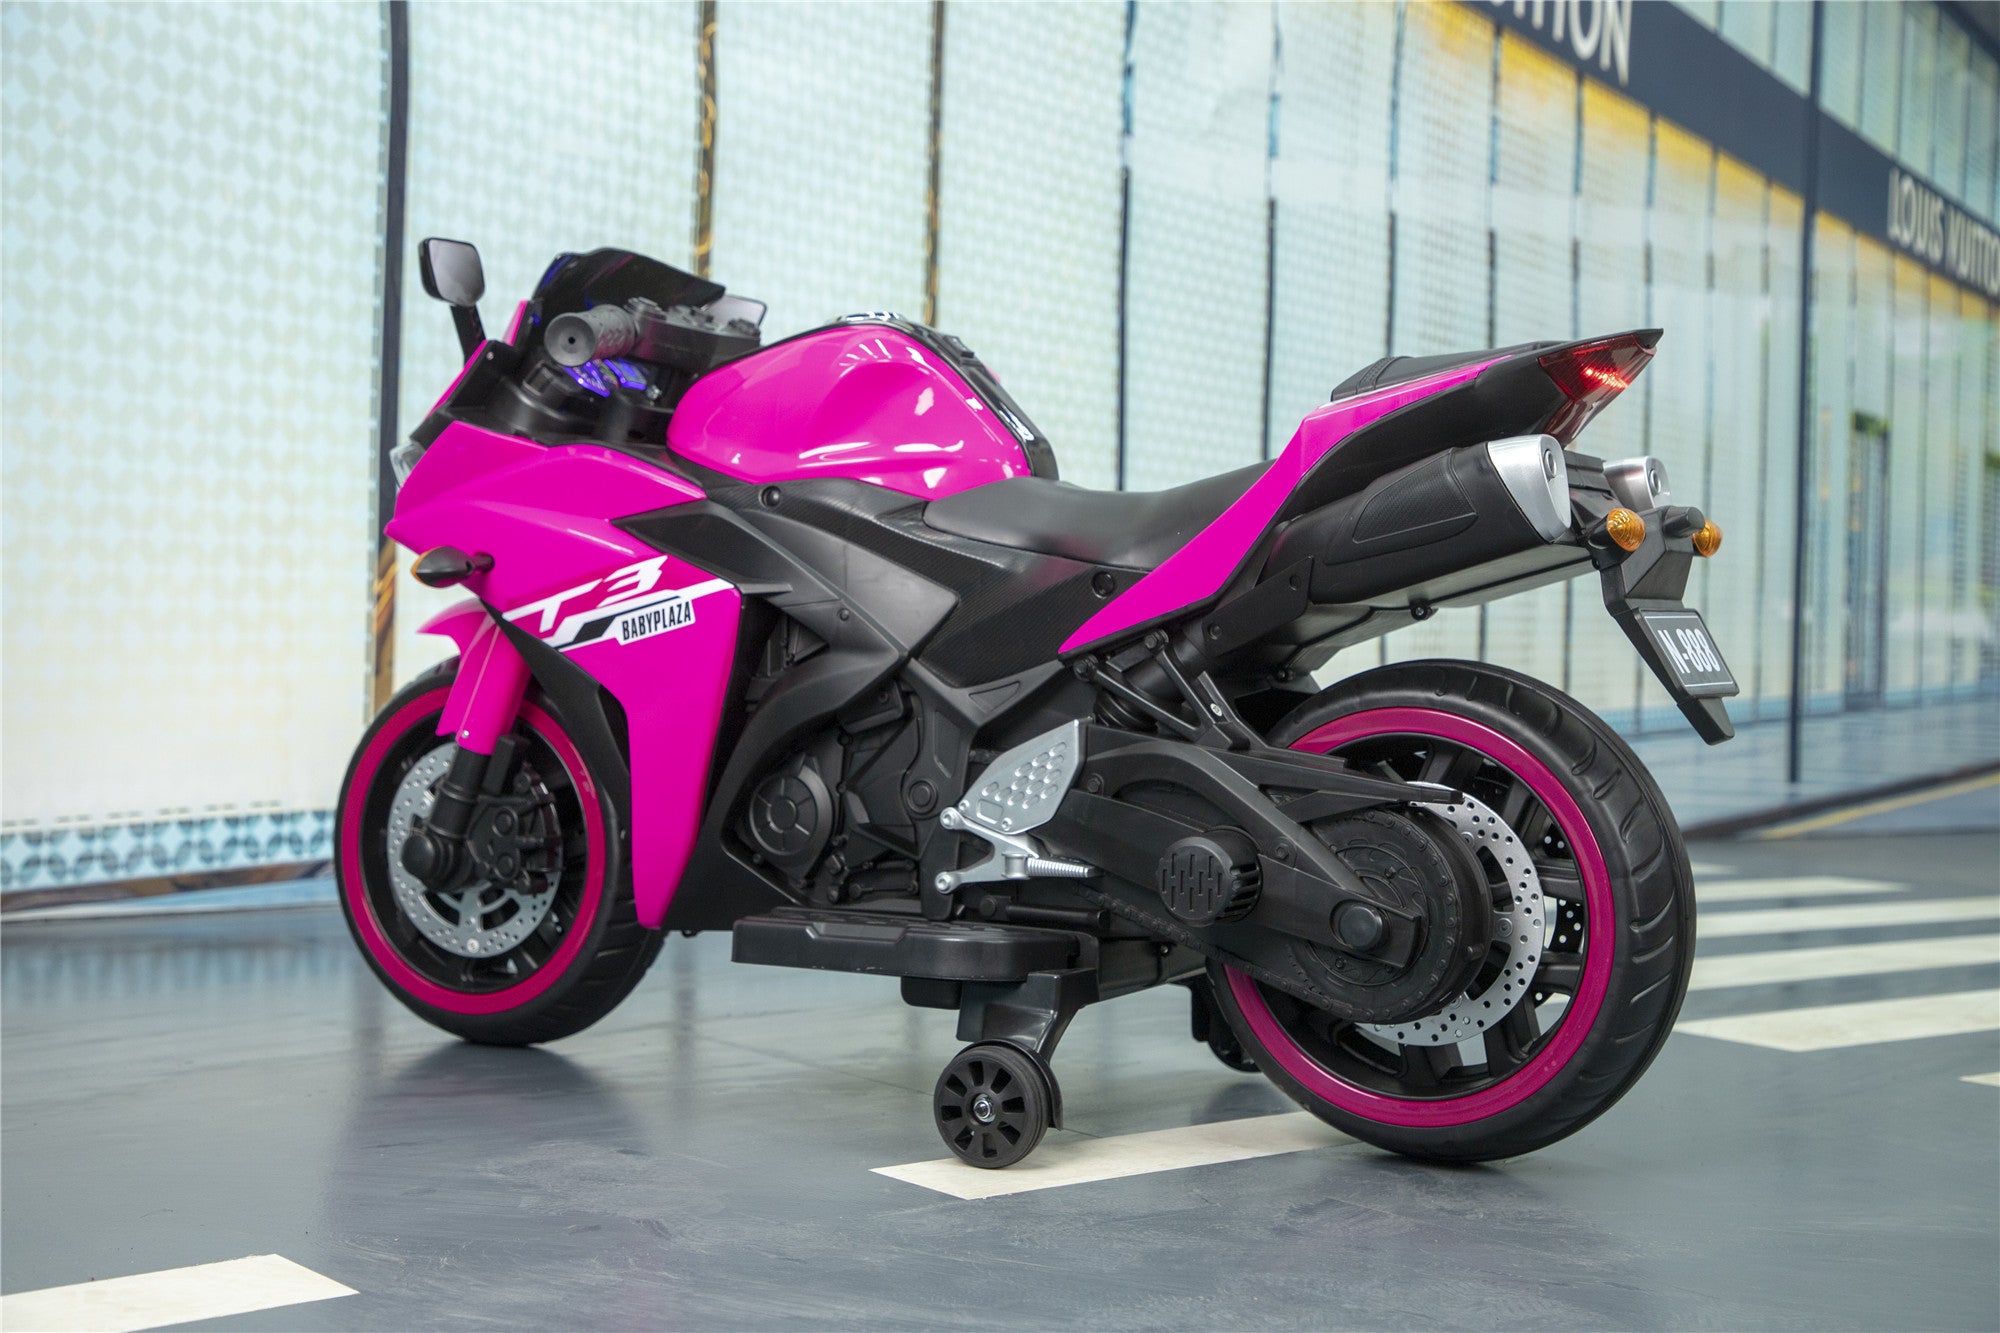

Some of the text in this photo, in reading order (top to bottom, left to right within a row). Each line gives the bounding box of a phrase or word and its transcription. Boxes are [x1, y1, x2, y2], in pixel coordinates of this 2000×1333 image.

[1887, 168, 1943, 265] LOUIS
[622, 602, 692, 641] BABYPLAZA
[1658, 628, 1721, 674] N-888
